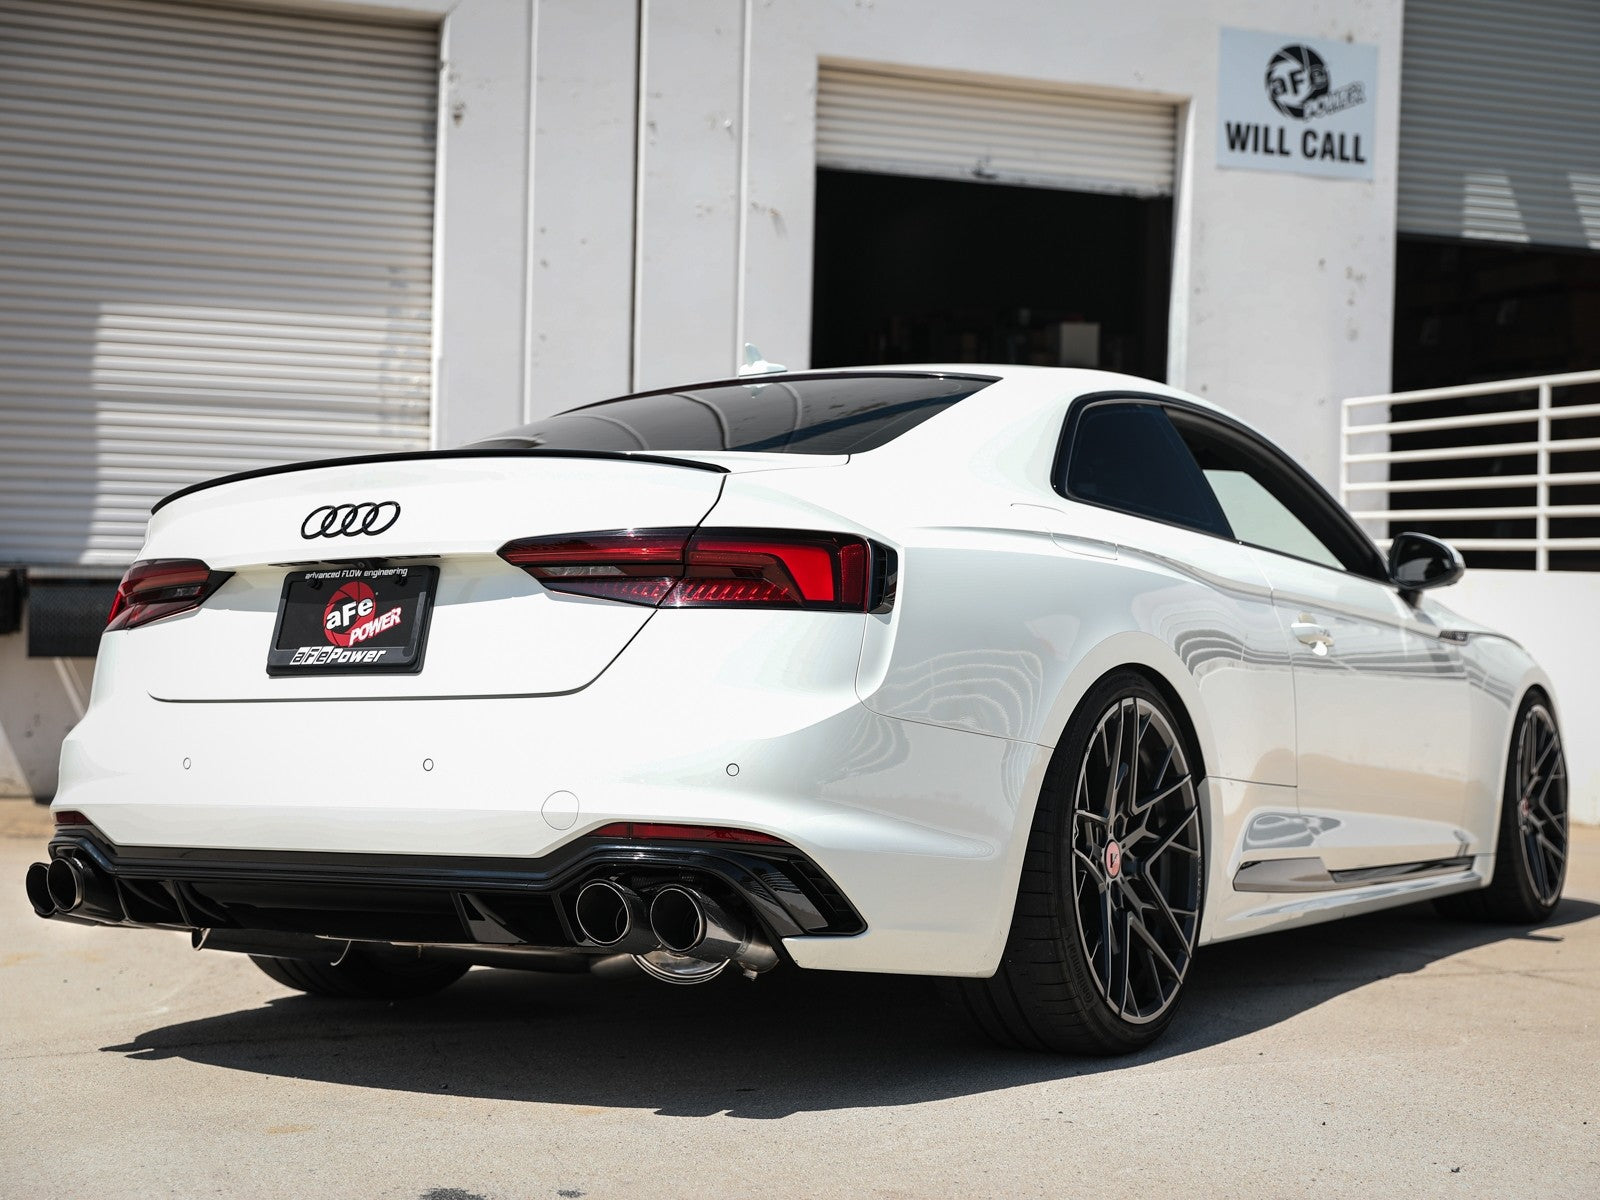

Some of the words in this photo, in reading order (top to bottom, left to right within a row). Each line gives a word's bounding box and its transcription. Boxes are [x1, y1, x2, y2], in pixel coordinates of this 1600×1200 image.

[1225, 121, 1291, 157] WILL
[1301, 129, 1366, 164] CALL
[305, 571, 340, 580] advanced
[364, 568, 408, 579] engineering
[326, 598, 374, 630] aFe
[349, 607, 402, 646] POWER
